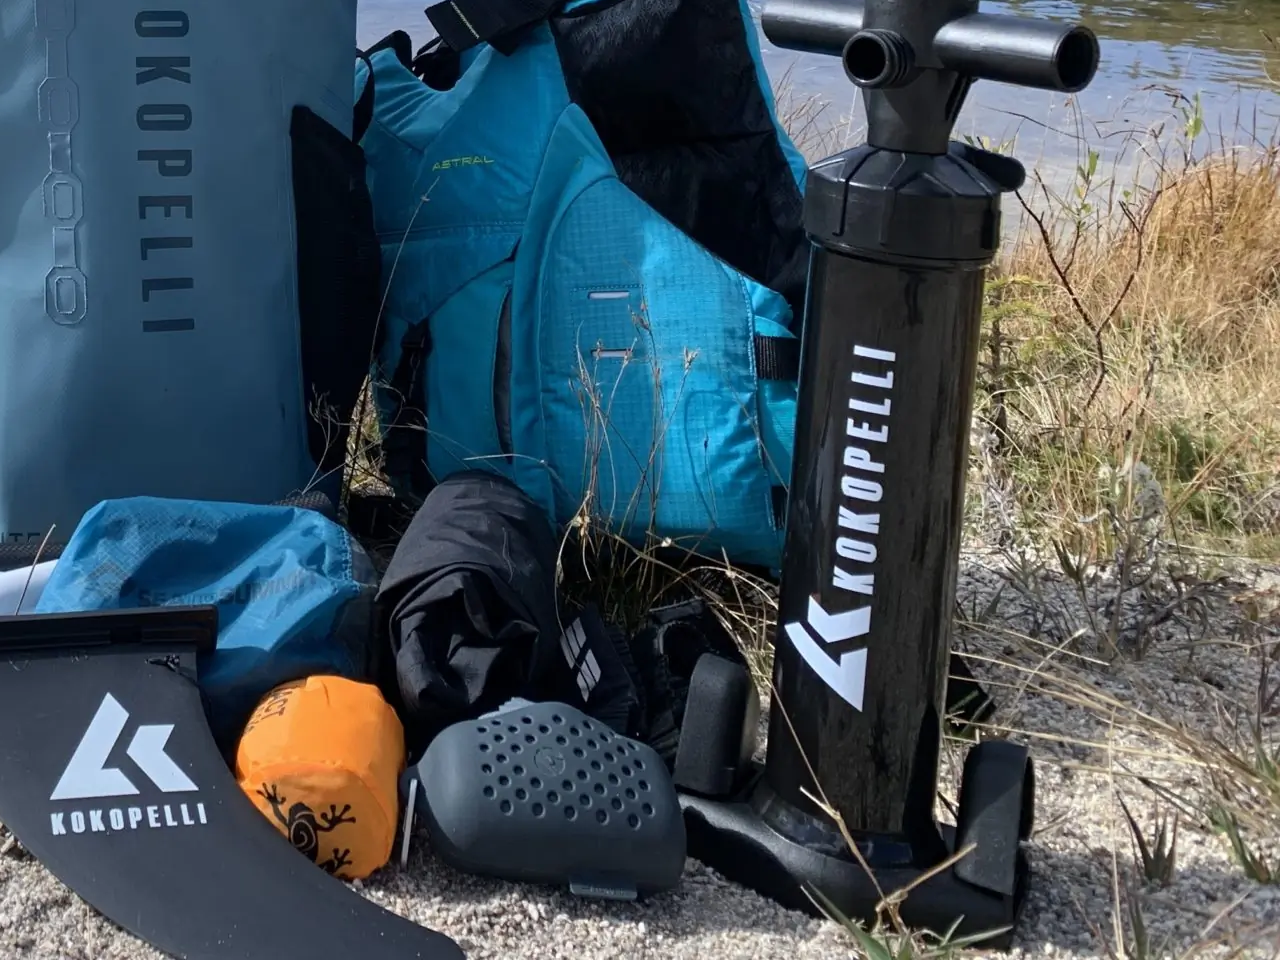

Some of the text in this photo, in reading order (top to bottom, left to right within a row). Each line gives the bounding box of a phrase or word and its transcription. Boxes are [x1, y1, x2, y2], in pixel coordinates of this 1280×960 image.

[432, 155, 495, 171] ASTRAL
[832, 344, 896, 596] KOKOPELLI
[50, 801, 208, 836] KOKOPELLI
